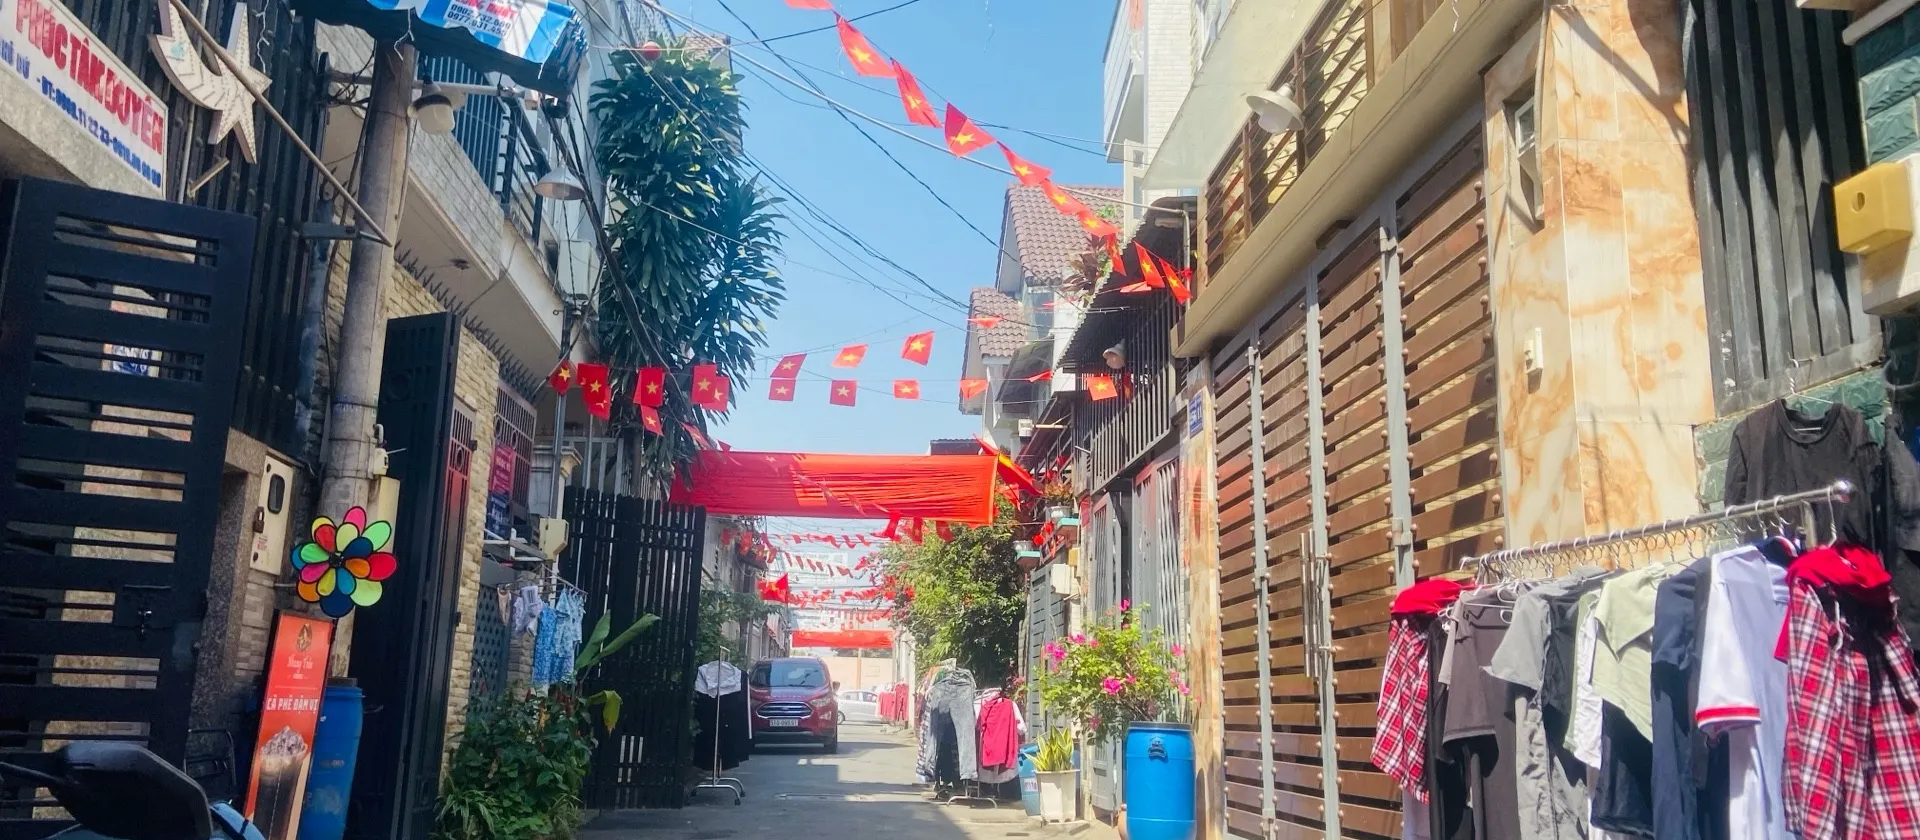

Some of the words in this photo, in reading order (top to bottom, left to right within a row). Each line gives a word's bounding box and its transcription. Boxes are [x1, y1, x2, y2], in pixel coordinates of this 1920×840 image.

[266, 694, 277, 710] CÀ
[278, 694, 293, 710] PHÊ
[293, 695, 309, 714] ĐẬM
[310, 698, 319, 714] VỊ
